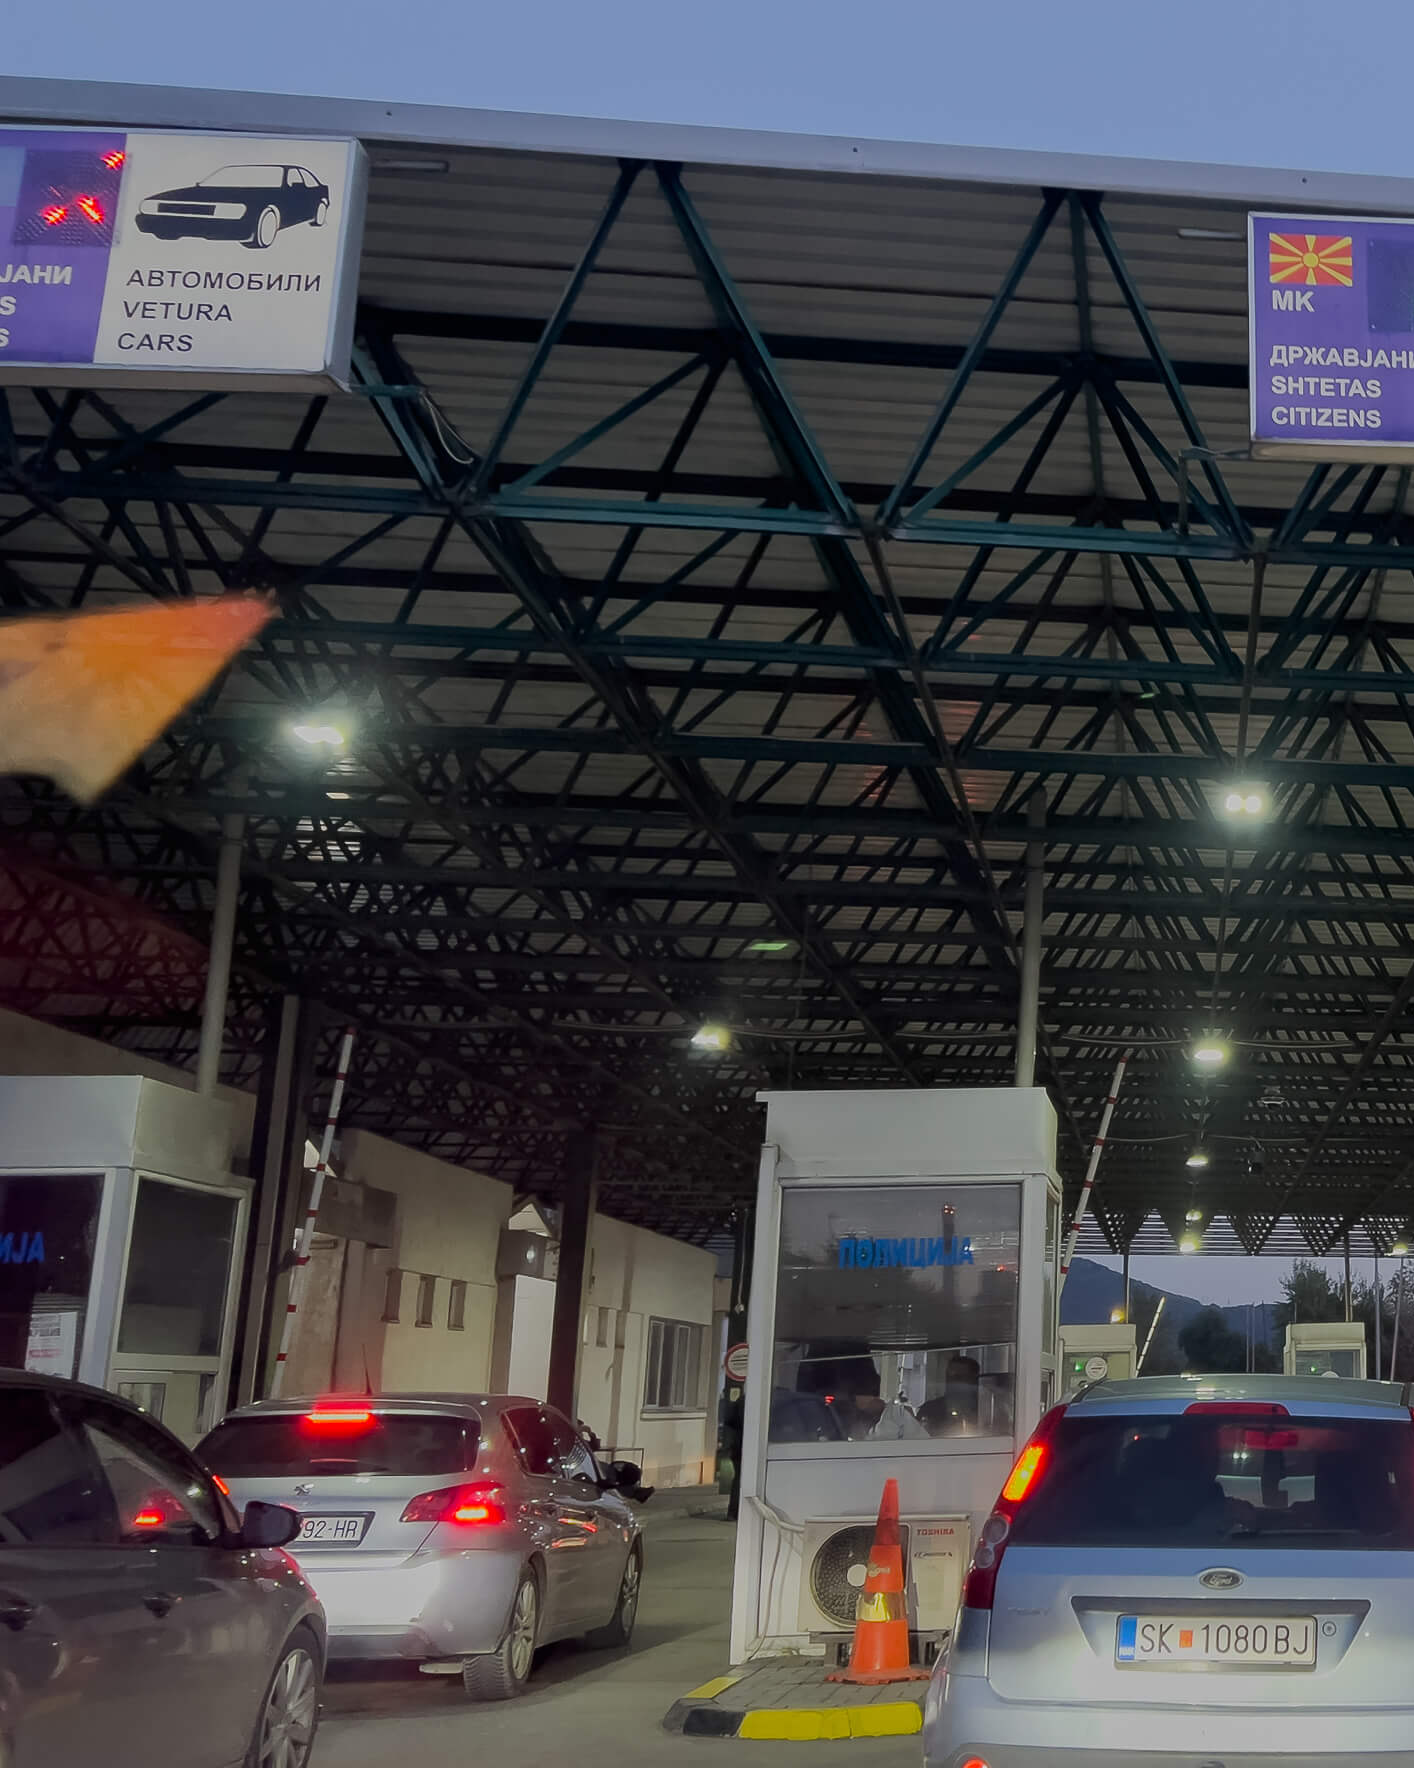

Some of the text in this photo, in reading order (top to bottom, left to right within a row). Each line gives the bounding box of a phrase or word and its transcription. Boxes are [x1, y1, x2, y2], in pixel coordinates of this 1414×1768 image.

[126, 269, 321, 292] АВТОМОБИЛИ
[123, 300, 233, 322] VETURA
[1271, 289, 1316, 313] MK
[117, 332, 194, 352] CARS
[1271, 374, 1382, 399] SHTETAS
[1271, 405, 1382, 429] CITIZENS
[839, 1236, 974, 1269] ПОЛИЦИЈА
[1140, 1623, 1174, 1654] SK
